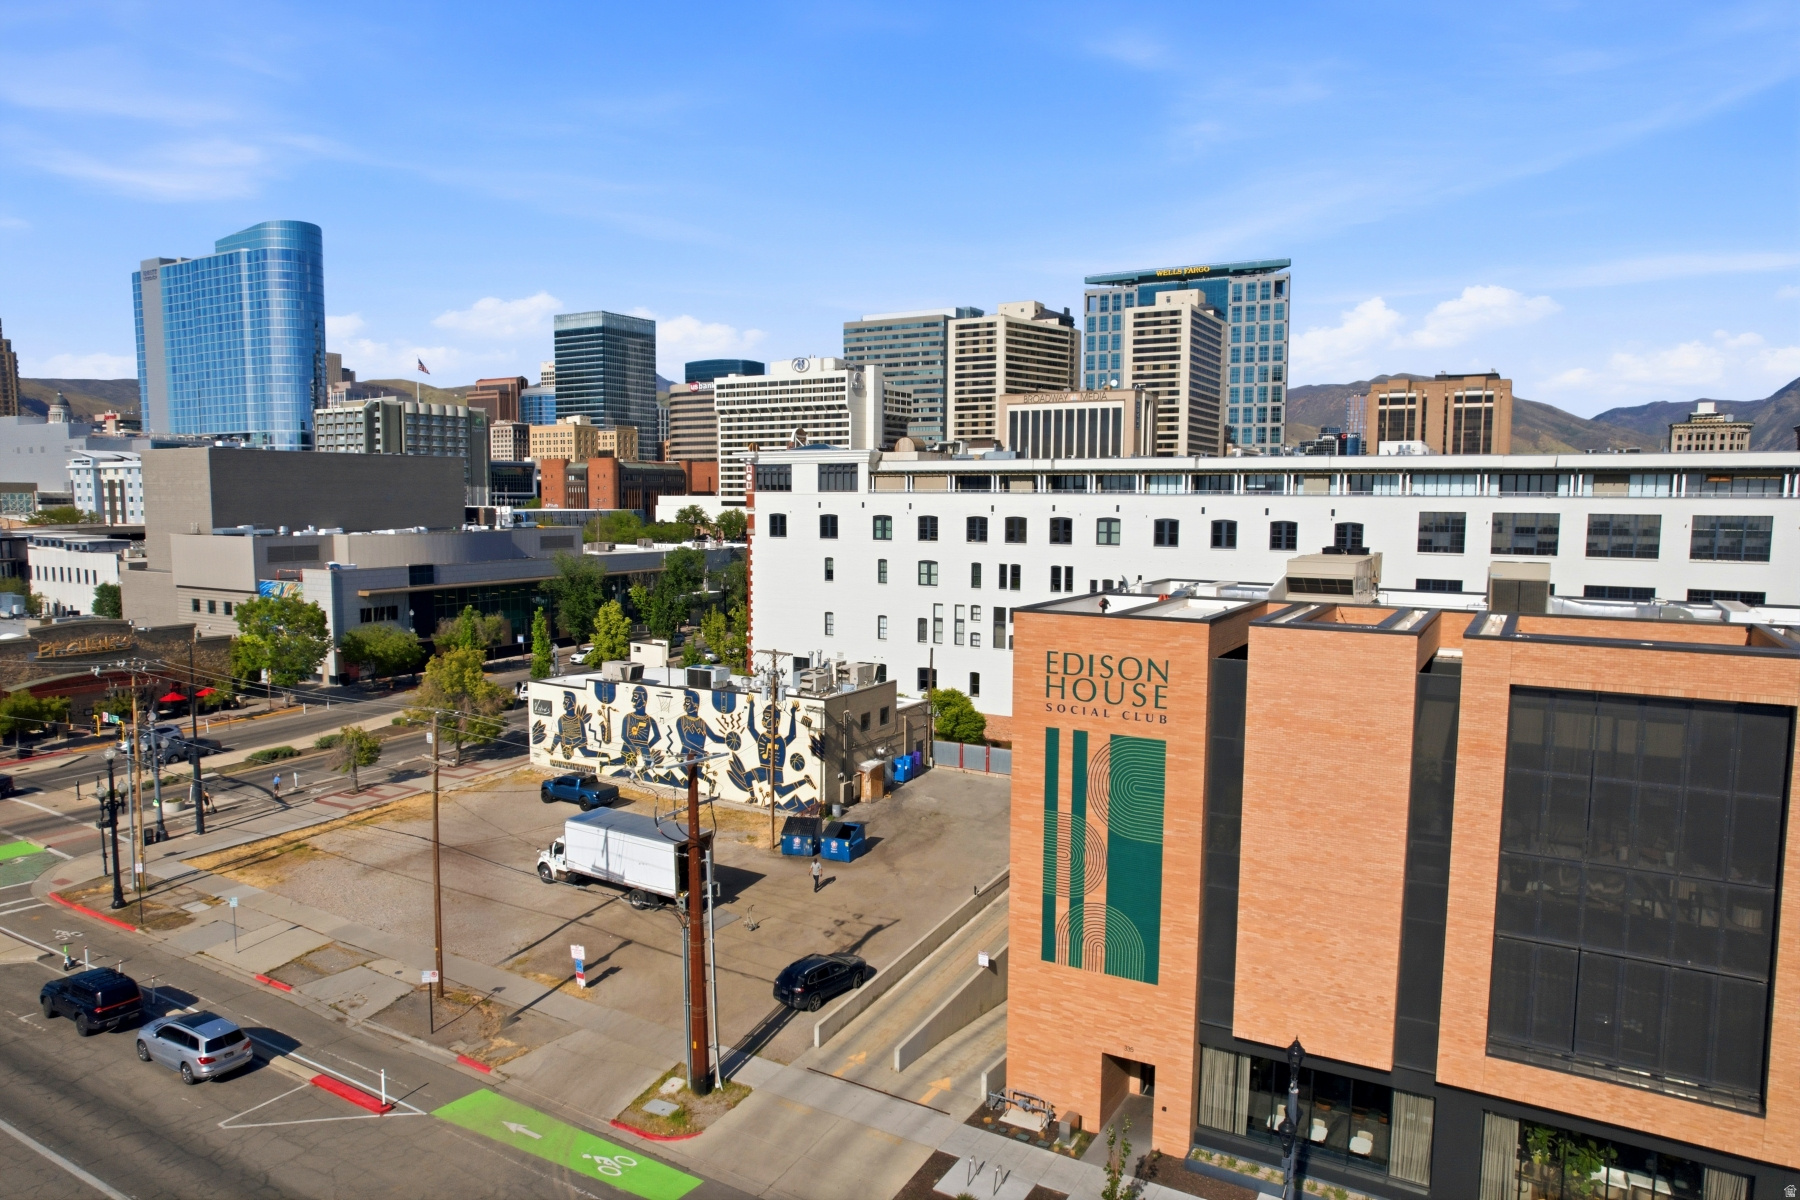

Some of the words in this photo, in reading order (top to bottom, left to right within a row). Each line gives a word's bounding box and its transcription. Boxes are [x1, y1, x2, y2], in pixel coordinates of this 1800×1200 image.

[1156, 268, 1182, 277] WELLS
[1184, 266, 1210, 275] FARGO
[1023, 393, 1069, 404] BROADWAY
[1080, 391, 1108, 401] MEDIA
[1046, 650, 1169, 684] EDISON
[1046, 675, 1168, 710] HOUSE
[1045, 702, 1110, 718] SOCIAL
[1121, 710, 1168, 724] CLUB
